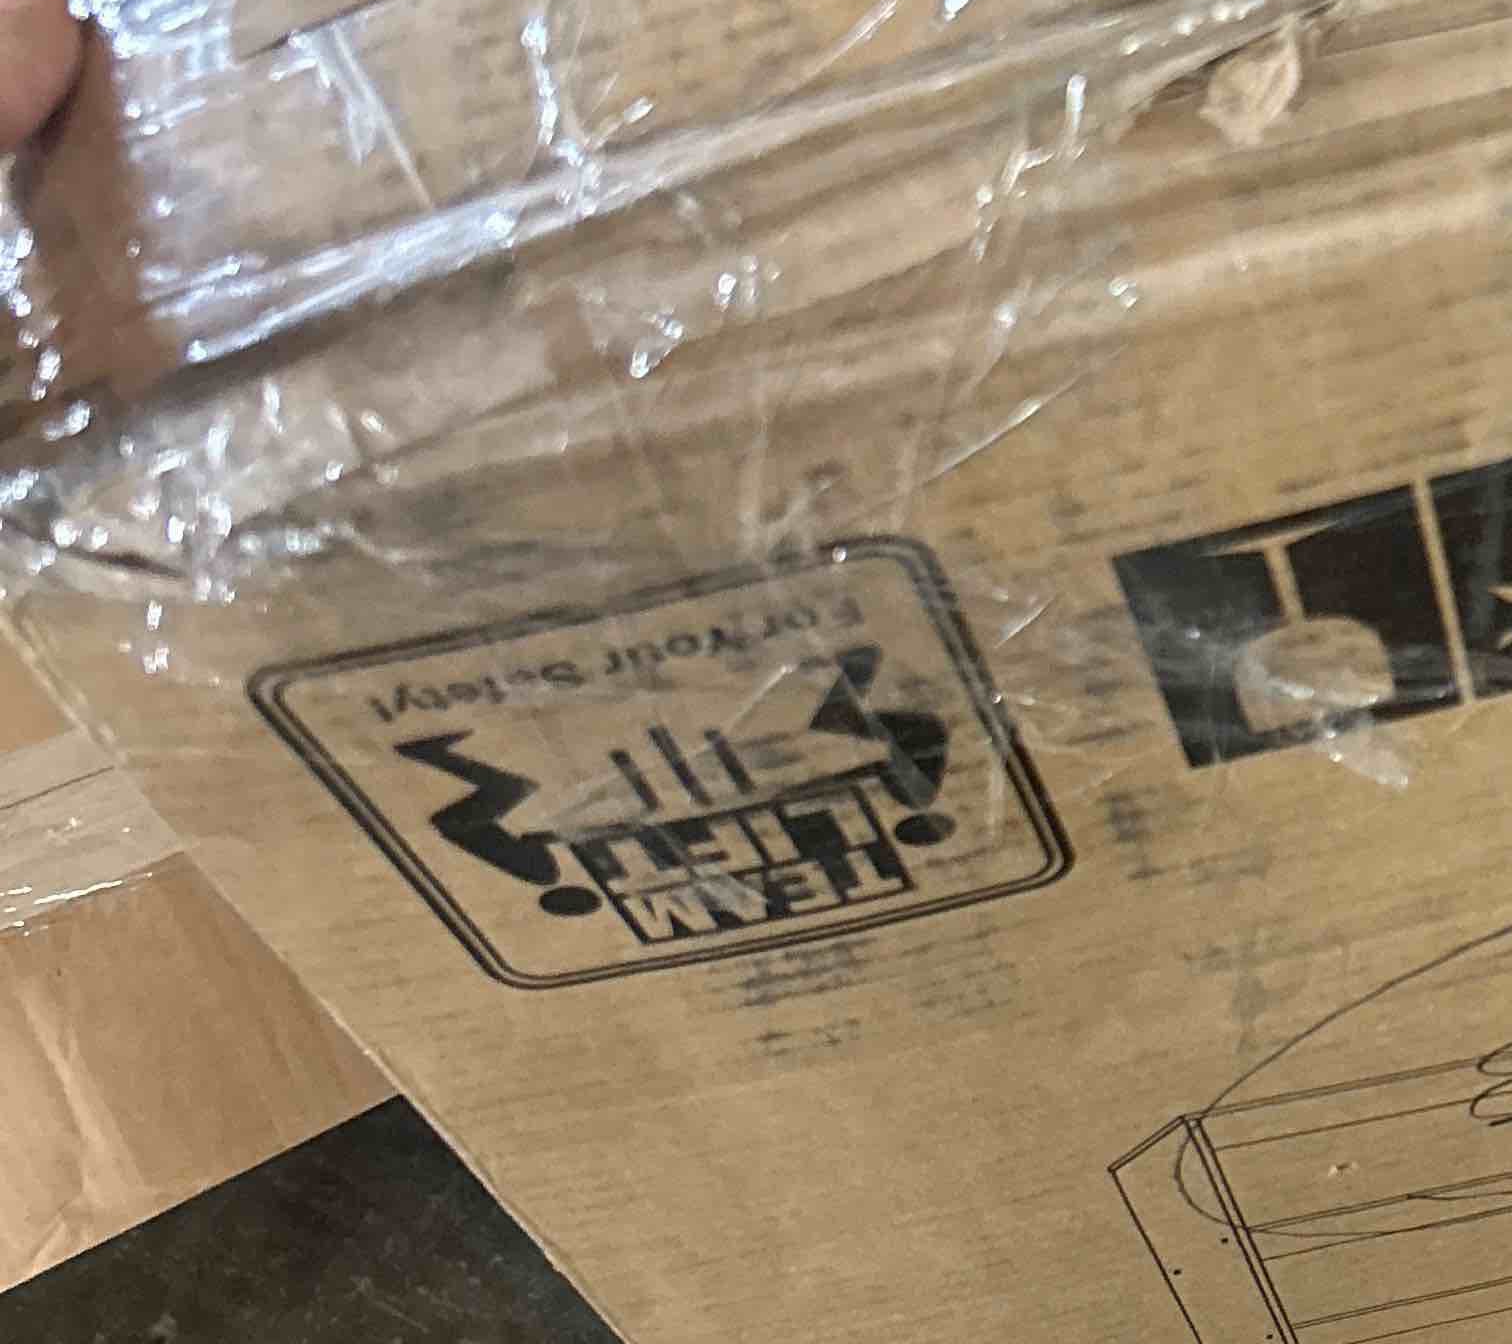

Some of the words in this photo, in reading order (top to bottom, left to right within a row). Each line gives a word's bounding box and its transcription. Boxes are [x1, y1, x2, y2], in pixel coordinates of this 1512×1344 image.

[603, 625, 747, 676] Your
[606, 797, 879, 895] LIFT
[622, 851, 903, 940] TEAM
